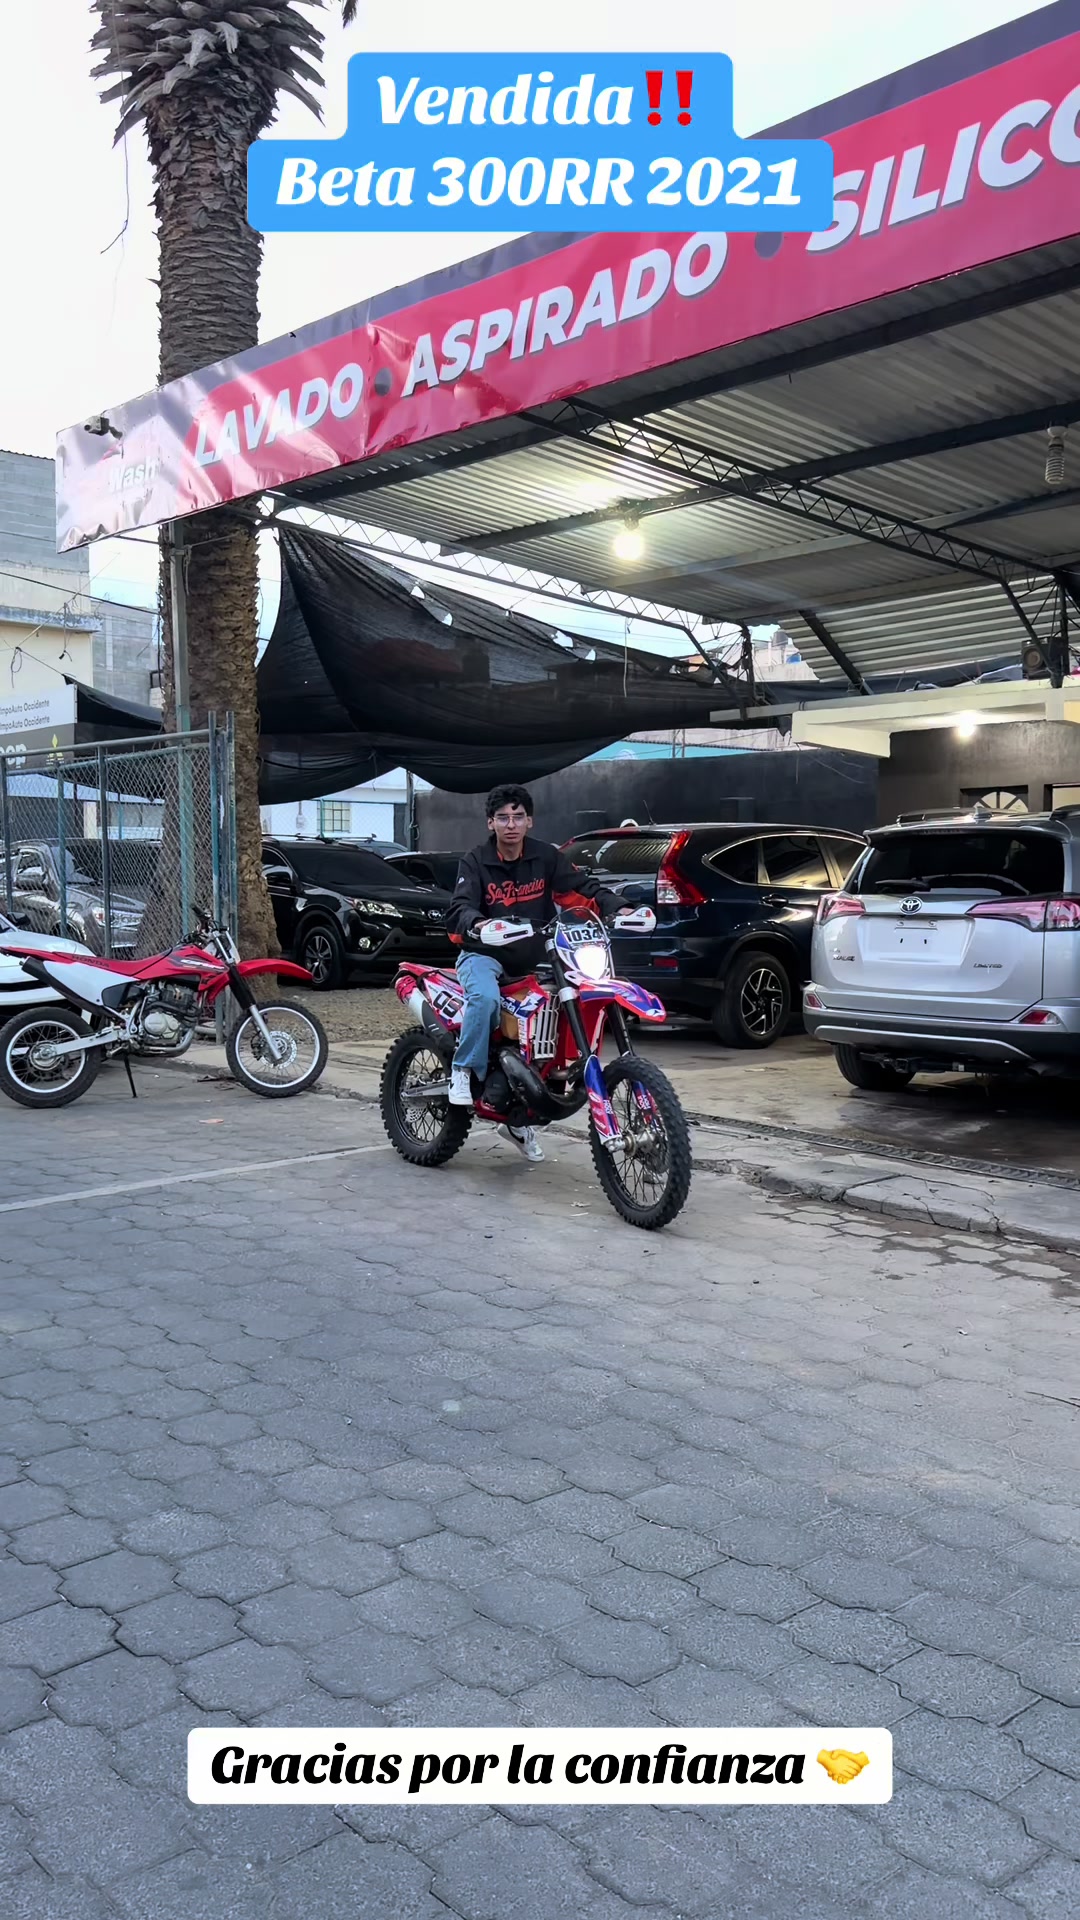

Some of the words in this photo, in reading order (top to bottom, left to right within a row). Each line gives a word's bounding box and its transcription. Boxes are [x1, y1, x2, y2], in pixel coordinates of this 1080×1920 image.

[193, 362, 365, 468] LAVADO
[400, 231, 729, 399] ASPIRADO
[23, 699, 50, 712] Occidente
[23, 715, 50, 728] Occidente
[564, 928, 602, 942] 1034
[71, 953, 110, 968] HONDA
[500, 997, 516, 1013] eta
